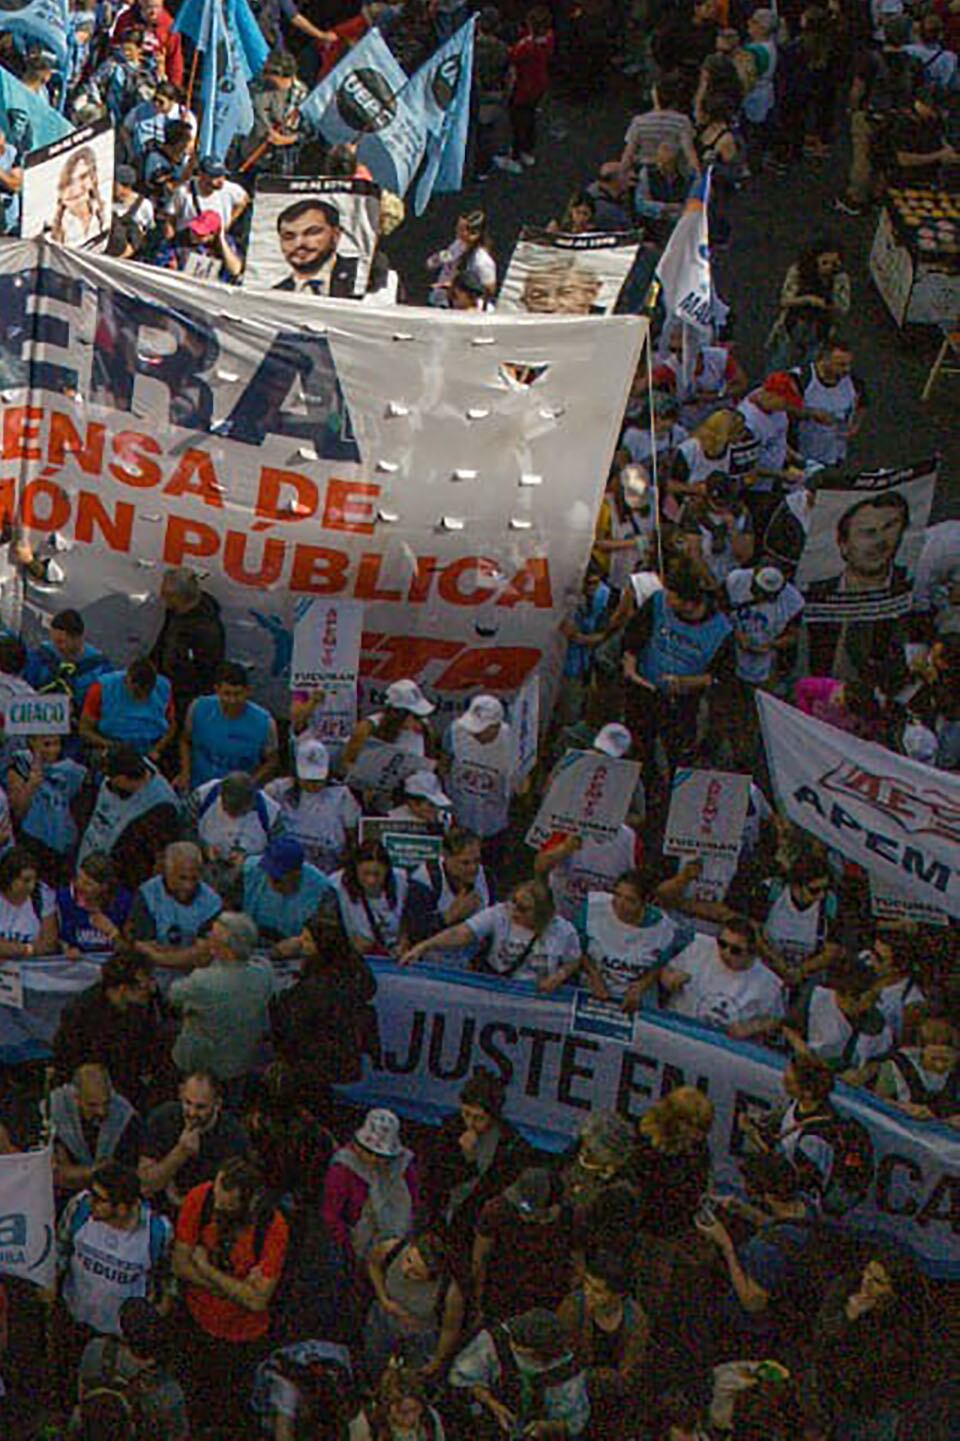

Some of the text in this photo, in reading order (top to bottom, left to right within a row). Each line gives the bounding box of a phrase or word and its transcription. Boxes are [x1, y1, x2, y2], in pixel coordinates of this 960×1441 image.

[343, 72, 395, 127] UEPC
[254, 466, 382, 535] DE
[163, 514, 554, 612] PÚBLICA
[793, 785, 960, 893] APEM
[360, 1012, 601, 1110] JUSTE
